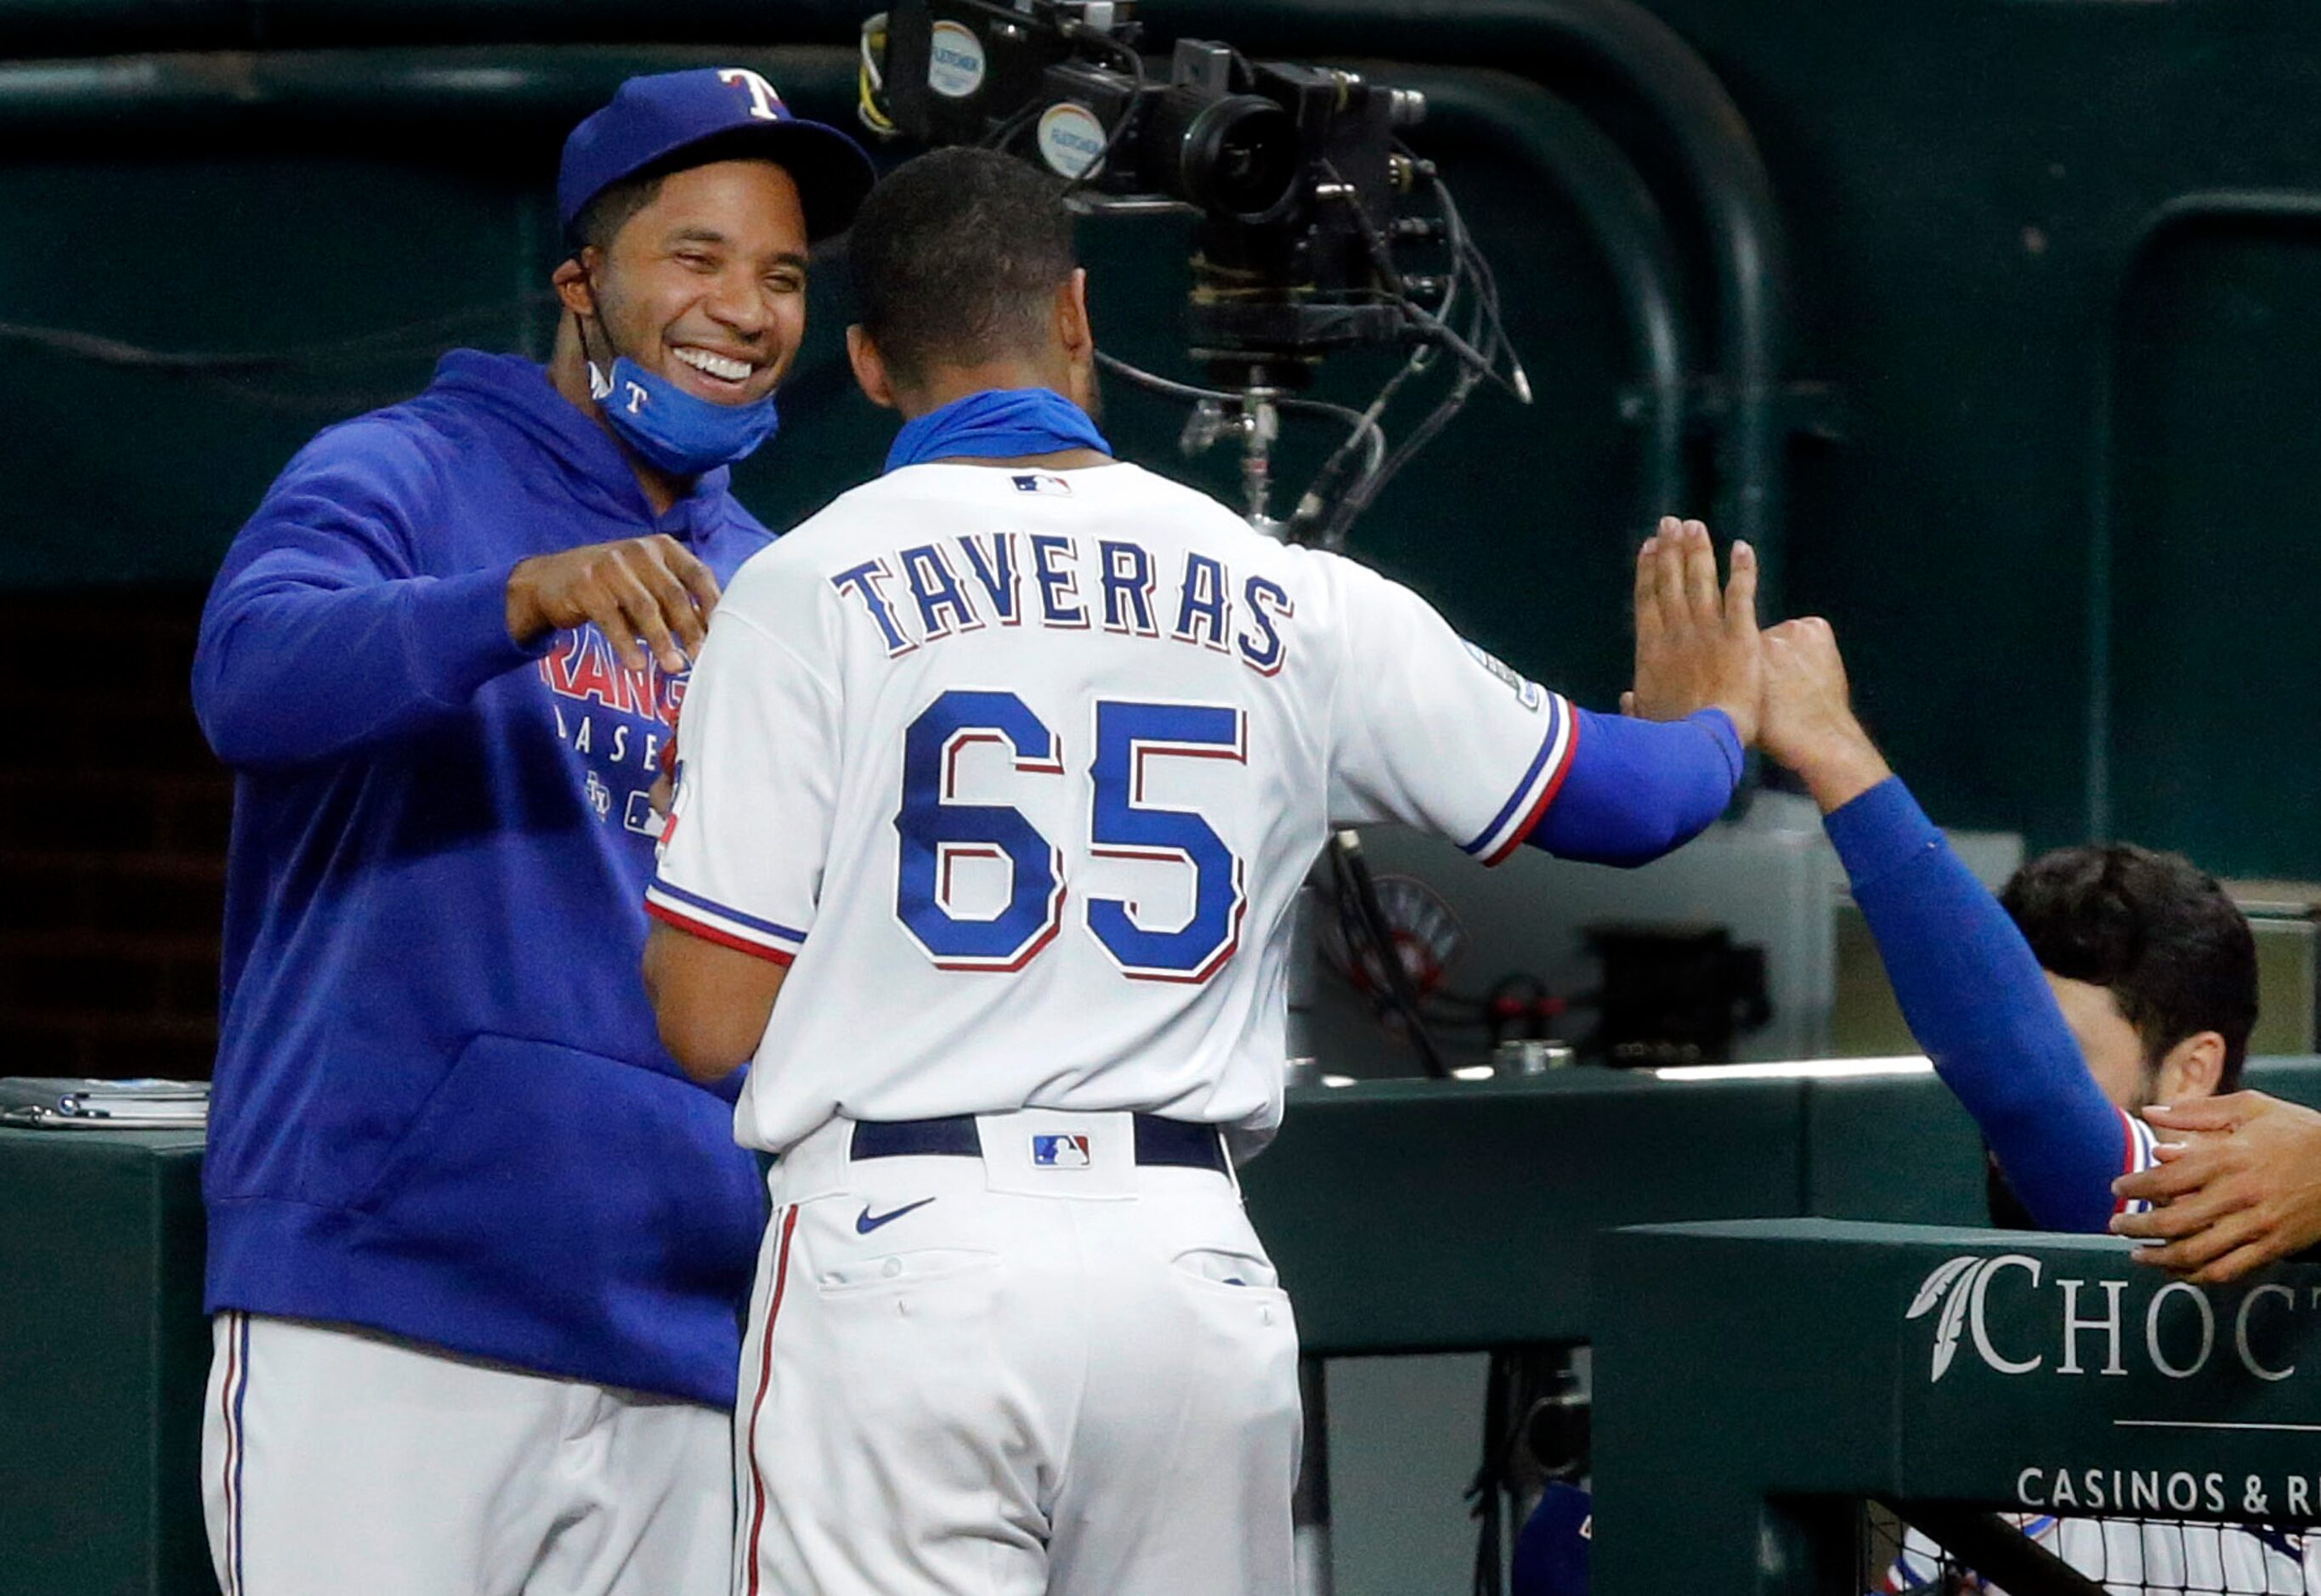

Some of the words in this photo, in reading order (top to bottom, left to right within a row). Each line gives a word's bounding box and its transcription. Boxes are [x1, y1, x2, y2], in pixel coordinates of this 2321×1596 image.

[716, 67, 784, 121] T
[625, 380, 649, 414] T
[830, 532, 1294, 678] TAVERAS
[892, 688, 1250, 985] 65
[2017, 1467, 2227, 1513] CASINOS
[2244, 1474, 2270, 1514] &
